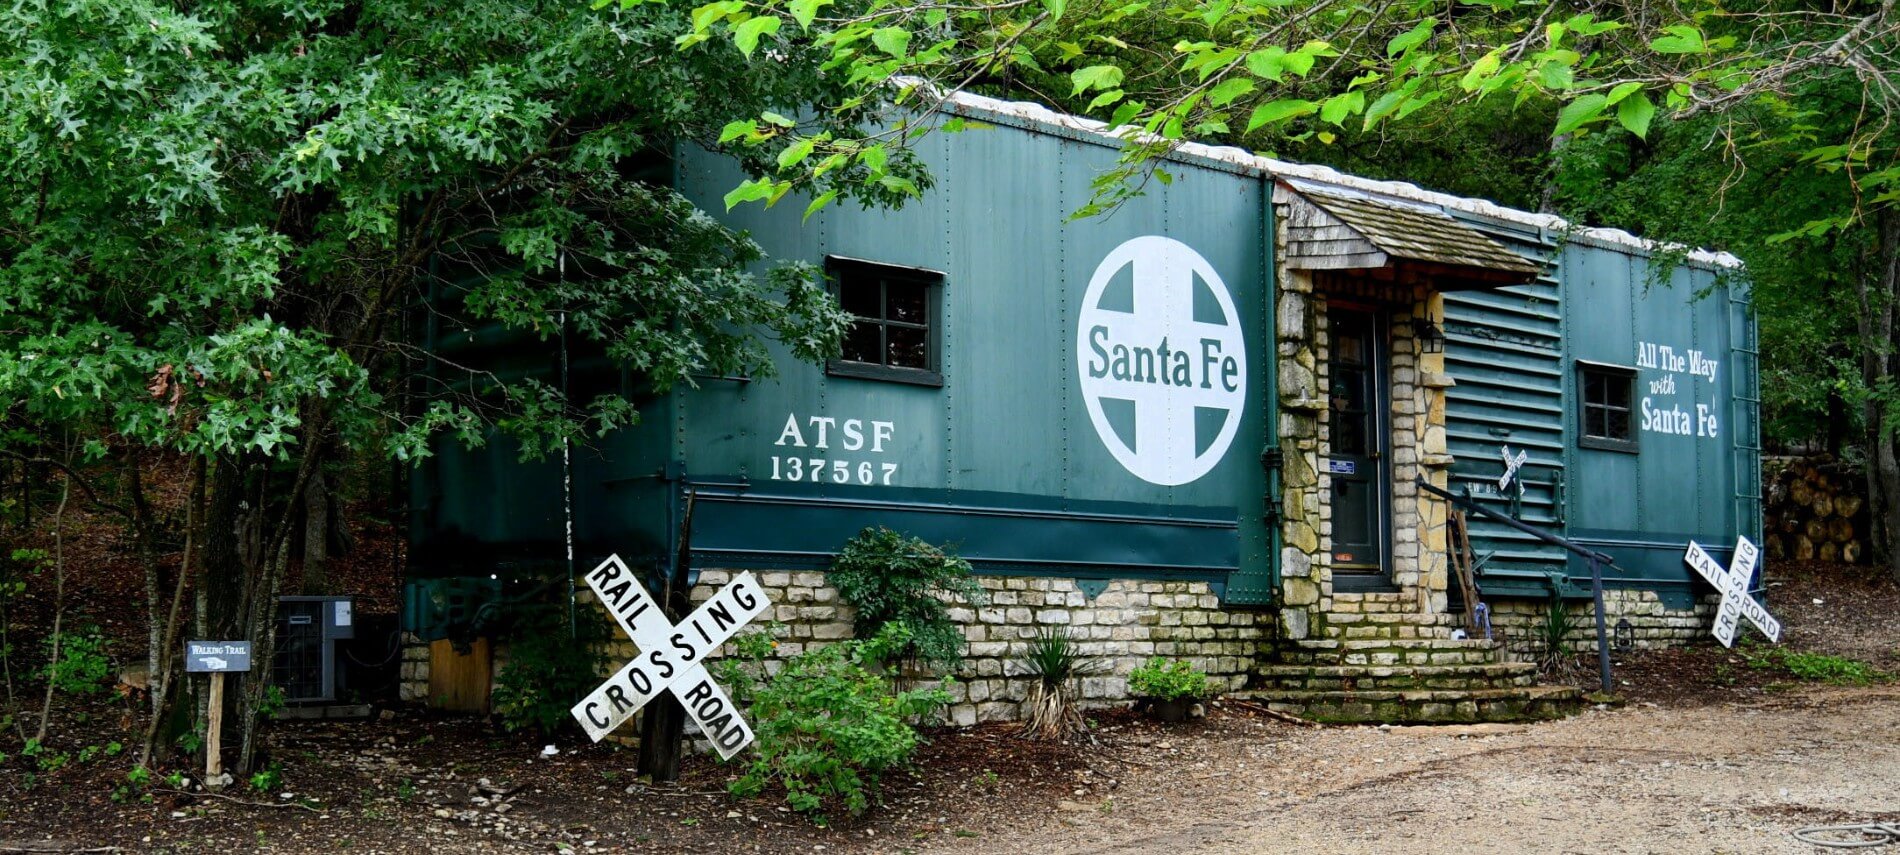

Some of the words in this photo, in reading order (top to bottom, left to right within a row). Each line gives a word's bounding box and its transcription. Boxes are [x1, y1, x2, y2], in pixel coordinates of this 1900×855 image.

[1089, 324, 1192, 387] Santa
[1200, 337, 1238, 392] Fe
[1636, 341, 1657, 369] All
[1659, 345, 1685, 373] The
[1687, 349, 1717, 383] Way
[1649, 373, 1676, 395] with
[774, 412, 894, 452] ATSF
[1641, 396, 1691, 435] Santa
[771, 456, 897, 485] 137567
[1689, 547, 1723, 589] RAIL
[1742, 597, 1777, 637] ROAD
[1717, 543, 1754, 641] CROSSING
[191, 645, 224, 655] WALKING
[224, 645, 247, 655] TRAIL
[585, 583, 756, 730] CROSSING
[592, 560, 649, 631] RAIL
[684, 680, 745, 751] ROAD
